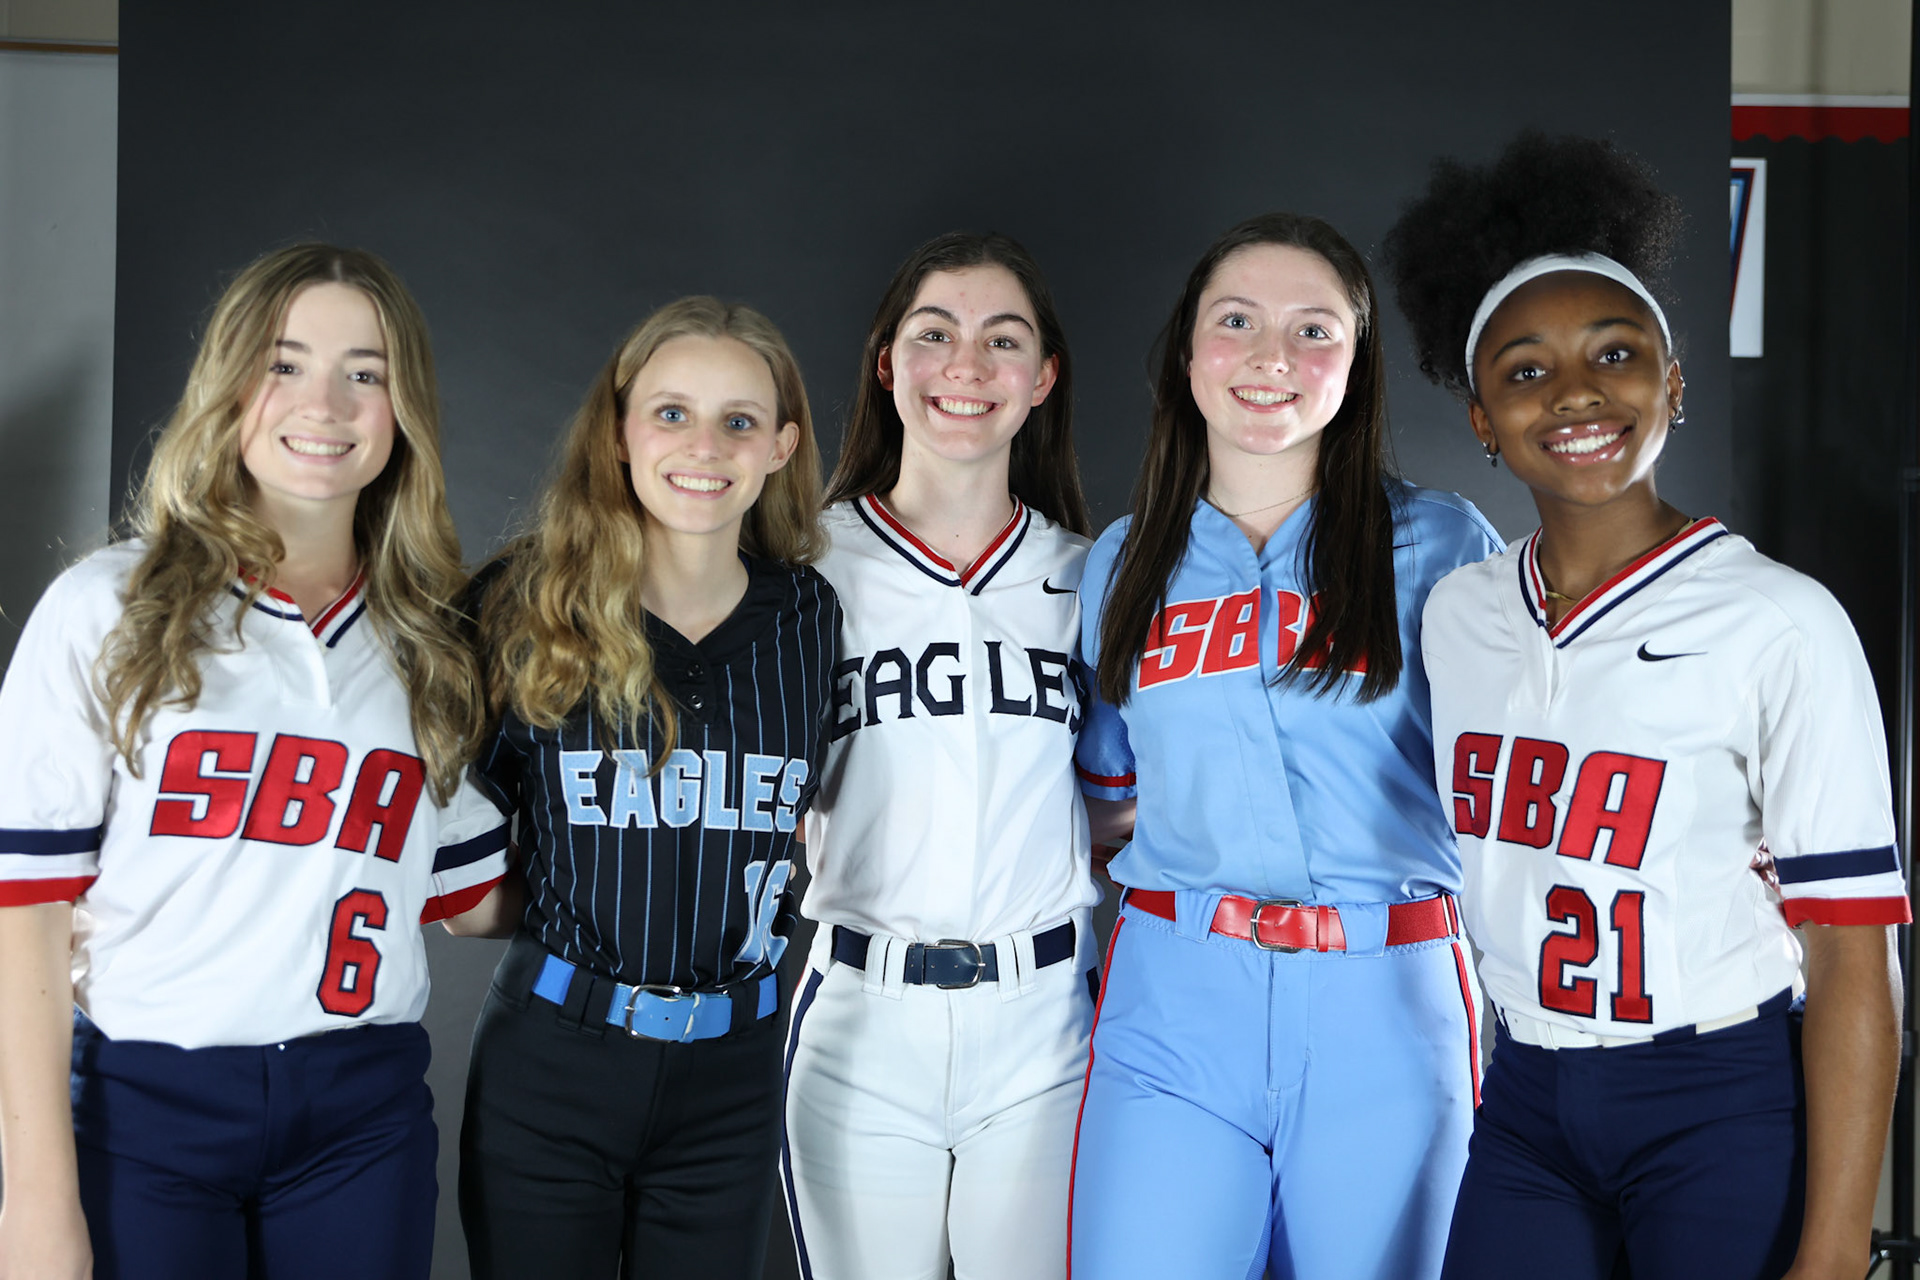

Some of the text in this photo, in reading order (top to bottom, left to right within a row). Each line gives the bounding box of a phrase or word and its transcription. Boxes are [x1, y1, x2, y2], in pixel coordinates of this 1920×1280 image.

[829, 640, 1091, 746] EAGLES
[1136, 585, 1368, 692] SB
[149, 729, 427, 863] SBA
[559, 748, 810, 832] EAGLES
[1452, 731, 1668, 871] SBA
[316, 887, 389, 1018] 6
[1537, 883, 1654, 1025] 21
